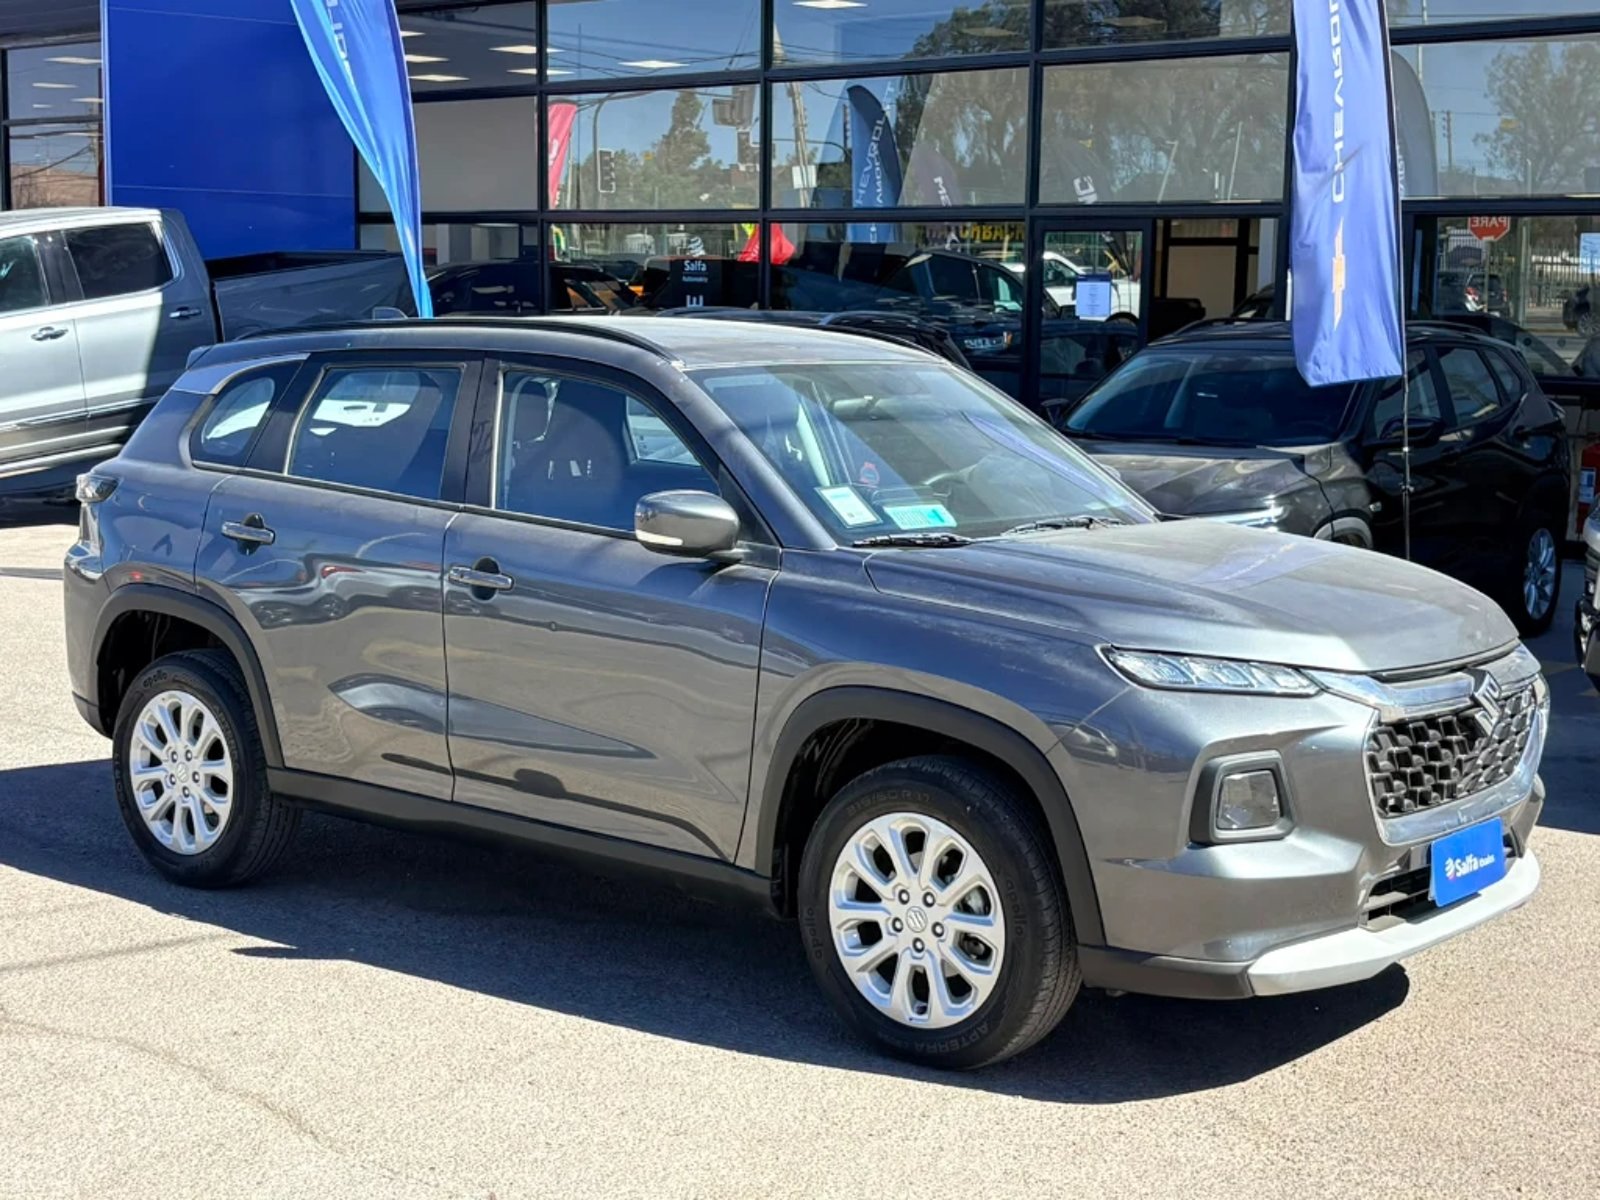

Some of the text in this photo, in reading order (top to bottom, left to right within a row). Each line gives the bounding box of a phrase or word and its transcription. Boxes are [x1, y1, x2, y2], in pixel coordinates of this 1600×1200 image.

[683, 260, 707, 272] Salfa
[1455, 853, 1478, 877] Salfa
[804, 907, 823, 960] apollo
